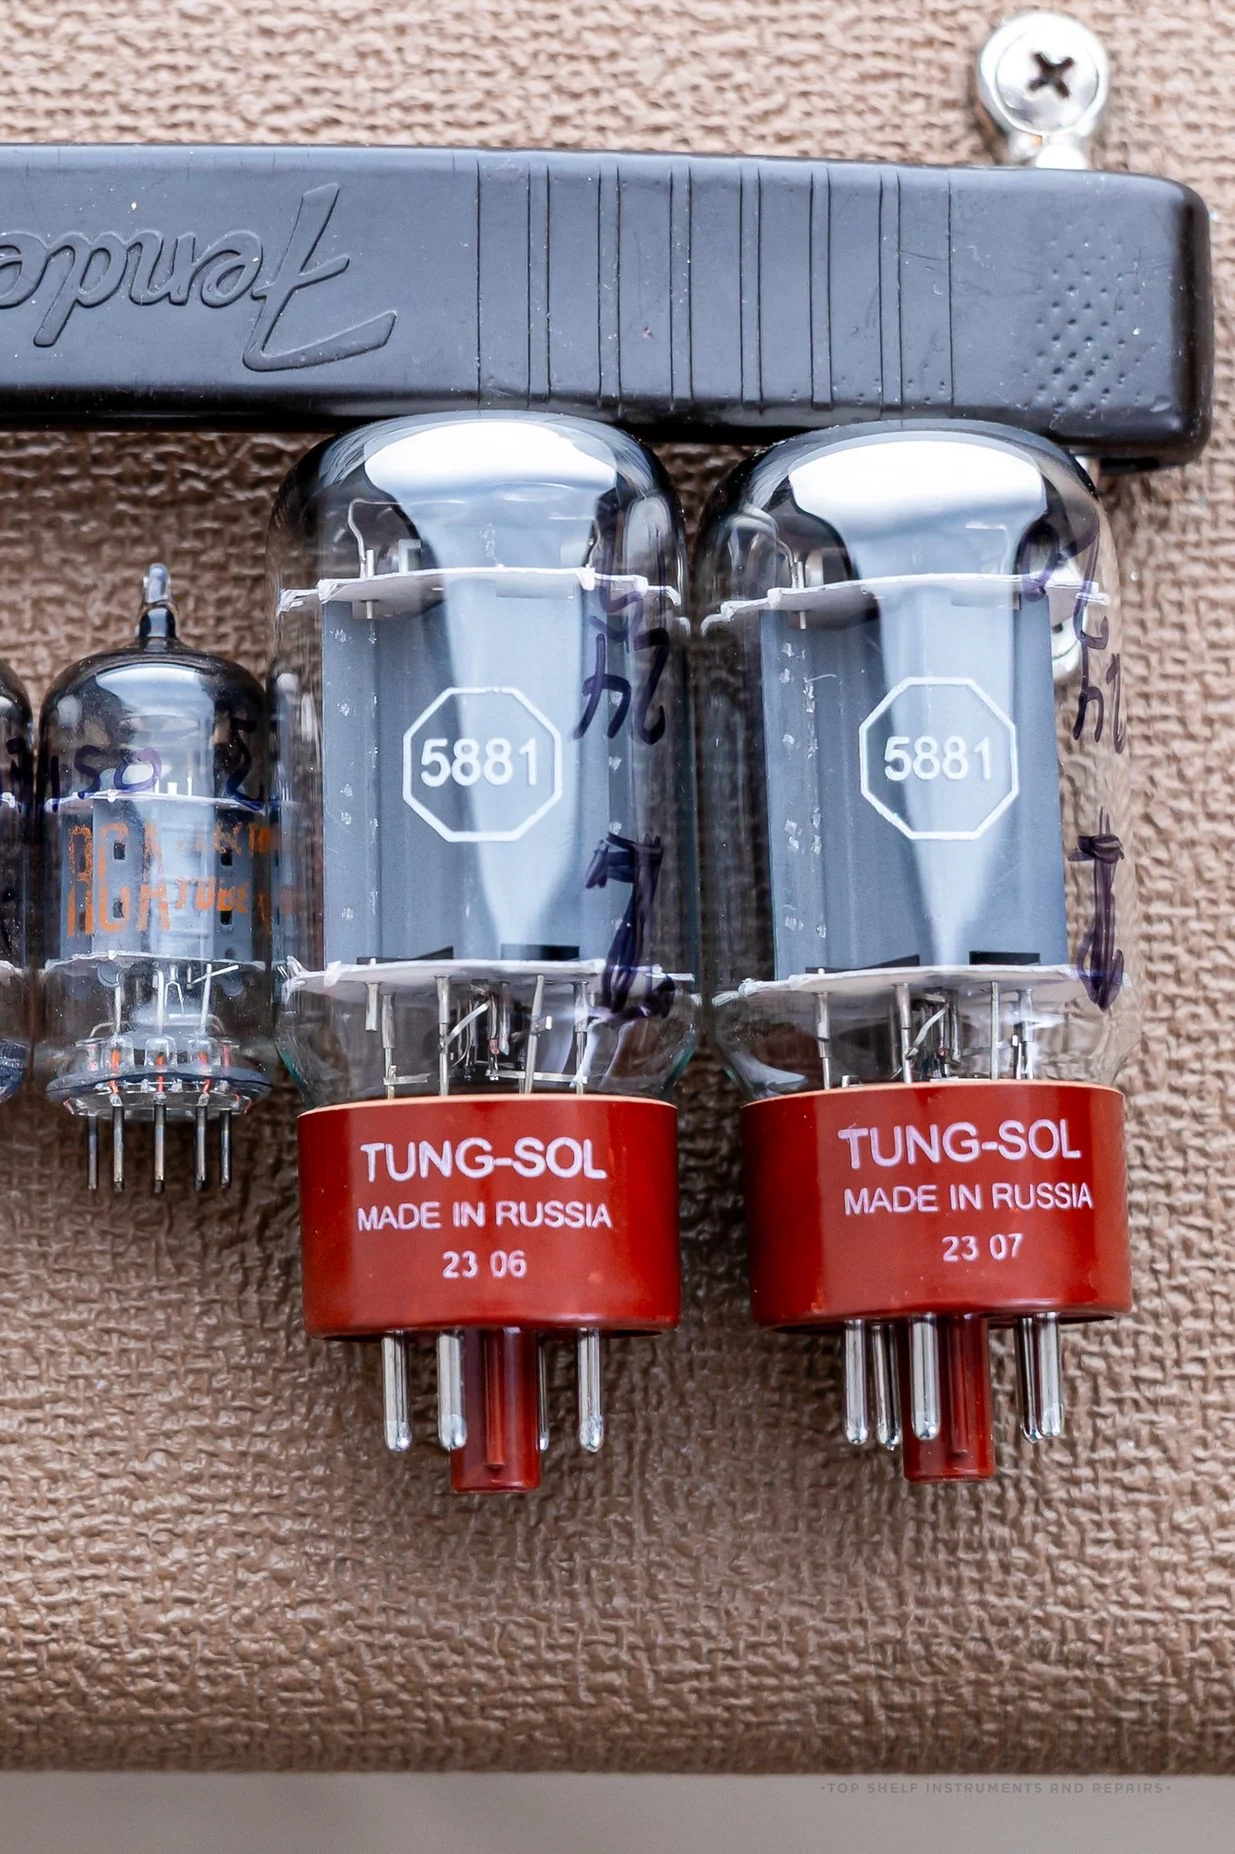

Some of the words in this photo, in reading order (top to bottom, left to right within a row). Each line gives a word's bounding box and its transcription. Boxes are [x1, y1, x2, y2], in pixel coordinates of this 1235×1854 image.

[420, 737, 537, 787] 5881
[884, 735, 991, 782] 5881
[360, 1137, 607, 1183] TUNG-SOL
[837, 1119, 1081, 1170] TUNG-SOL
[357, 1201, 442, 1231] MADE
[453, 1202, 486, 1227] IN
[496, 1201, 612, 1229] RUSSIA
[844, 1185, 939, 1216] MADE
[951, 1184, 983, 1210] IN
[992, 1182, 1093, 1210] RUSSIA
[442, 1250, 478, 1279] 23
[491, 1249, 527, 1278] 06
[943, 1235, 979, 1263] 23
[990, 1232, 1023, 1261] 07
